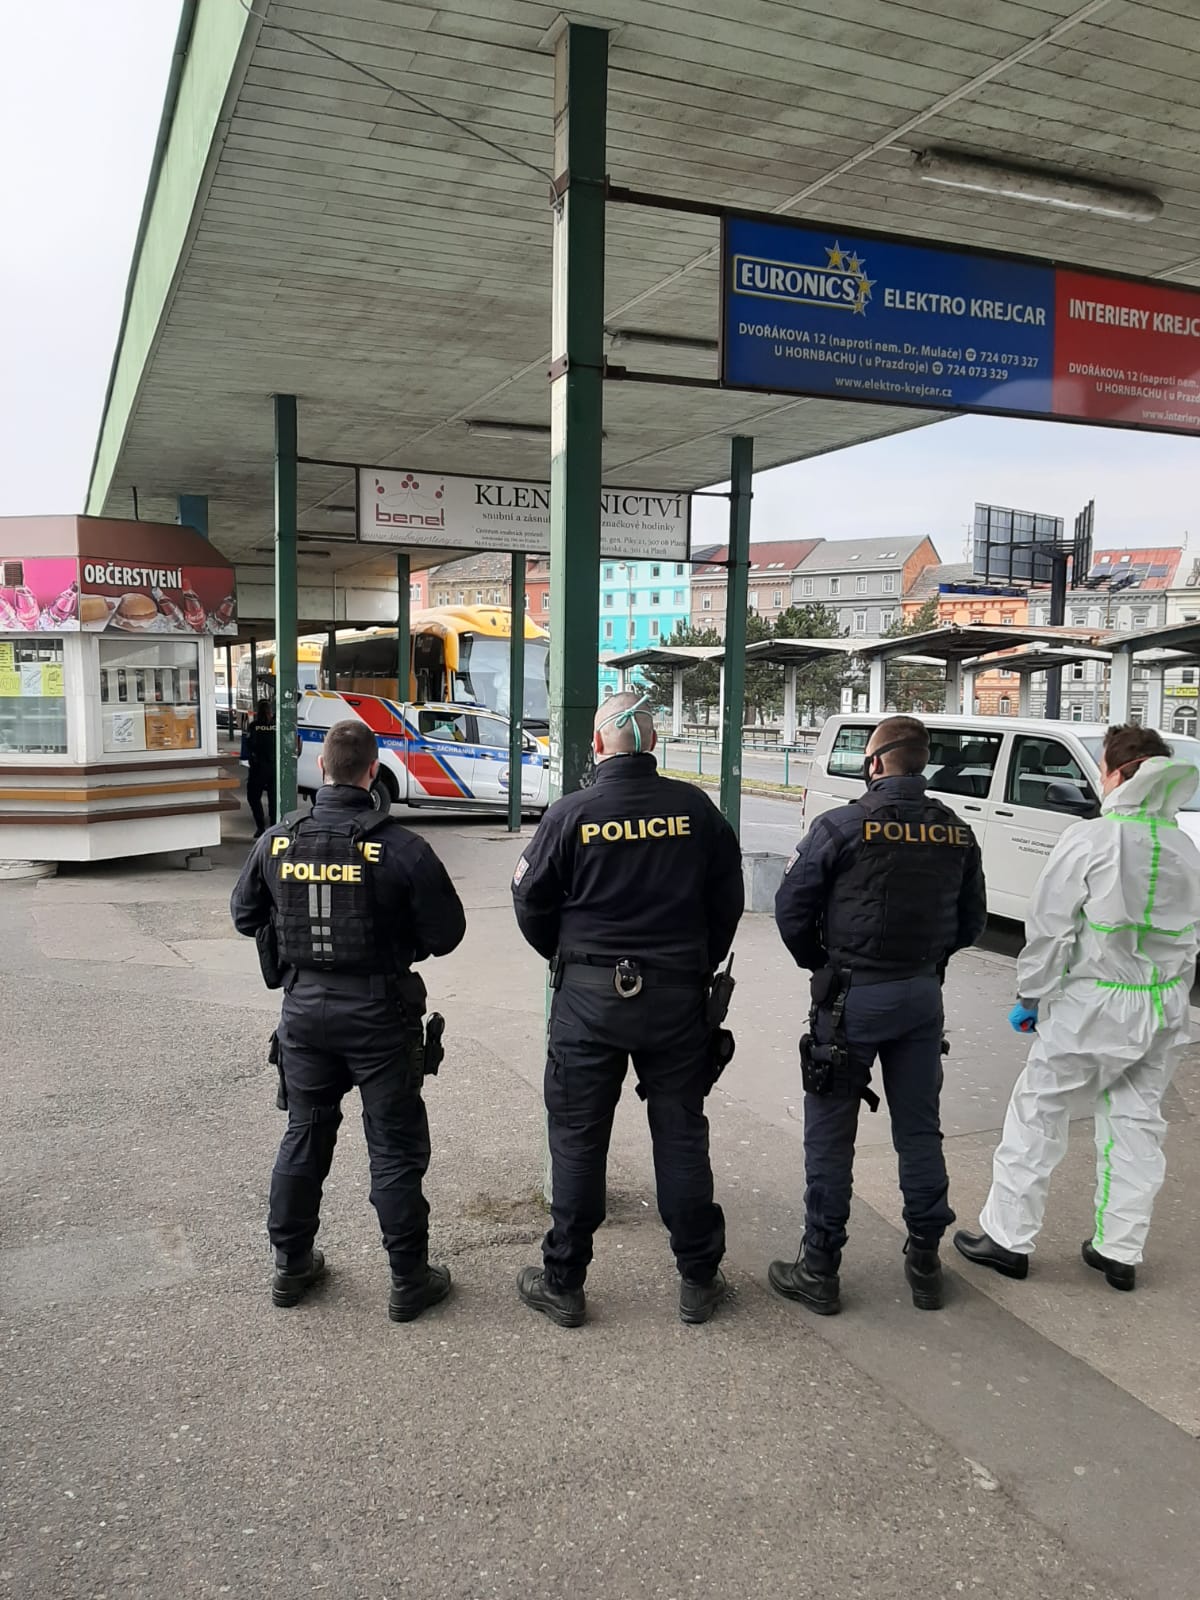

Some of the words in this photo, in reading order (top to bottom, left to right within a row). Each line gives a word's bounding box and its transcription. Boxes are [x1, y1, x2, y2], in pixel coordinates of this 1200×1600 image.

[741, 263, 856, 301] EURONICS
[884, 288, 966, 316] ELEKTRO
[970, 299, 1046, 326] KREJCAR
[1069, 298, 1150, 330] INTERIERY
[739, 322, 810, 343] DVOŘÁKOVA
[813, 333, 826, 345] 12
[875, 340, 902, 353] nem.
[904, 343, 919, 356] Dr.
[921, 345, 962, 361] Mulače)
[980, 351, 998, 363] 724
[1001, 354, 1019, 365] 073
[1021, 356, 1039, 368] 327
[774, 345, 782, 357] U
[785, 346, 856, 365] HORNBACHU
[874, 356, 929, 374] Prazdroje)
[947, 364, 966, 376] 724
[968, 366, 987, 378] 073
[989, 368, 1008, 380] 329
[1069, 362, 1125, 380] DVOŘÁKOVA
[1127, 371, 1138, 381] 12
[834, 376, 953, 398] www.elektro-krejcar.cz
[1096, 381, 1103, 392] U
[1105, 384, 1162, 399] HORNBACHU
[376, 503, 445, 526] benel
[474, 484, 683, 518] KLENICTVÍ
[482, 511, 513, 521] snubní
[523, 514, 550, 524] zásnu
[602, 520, 640, 529] značkové
[641, 521, 675, 533] hodinky
[84, 562, 183, 589] OBČERSTVENÍ
[581, 815, 691, 844] POLICIE
[865, 821, 971, 845] POLICIE
[281, 862, 362, 882] POLICIE
